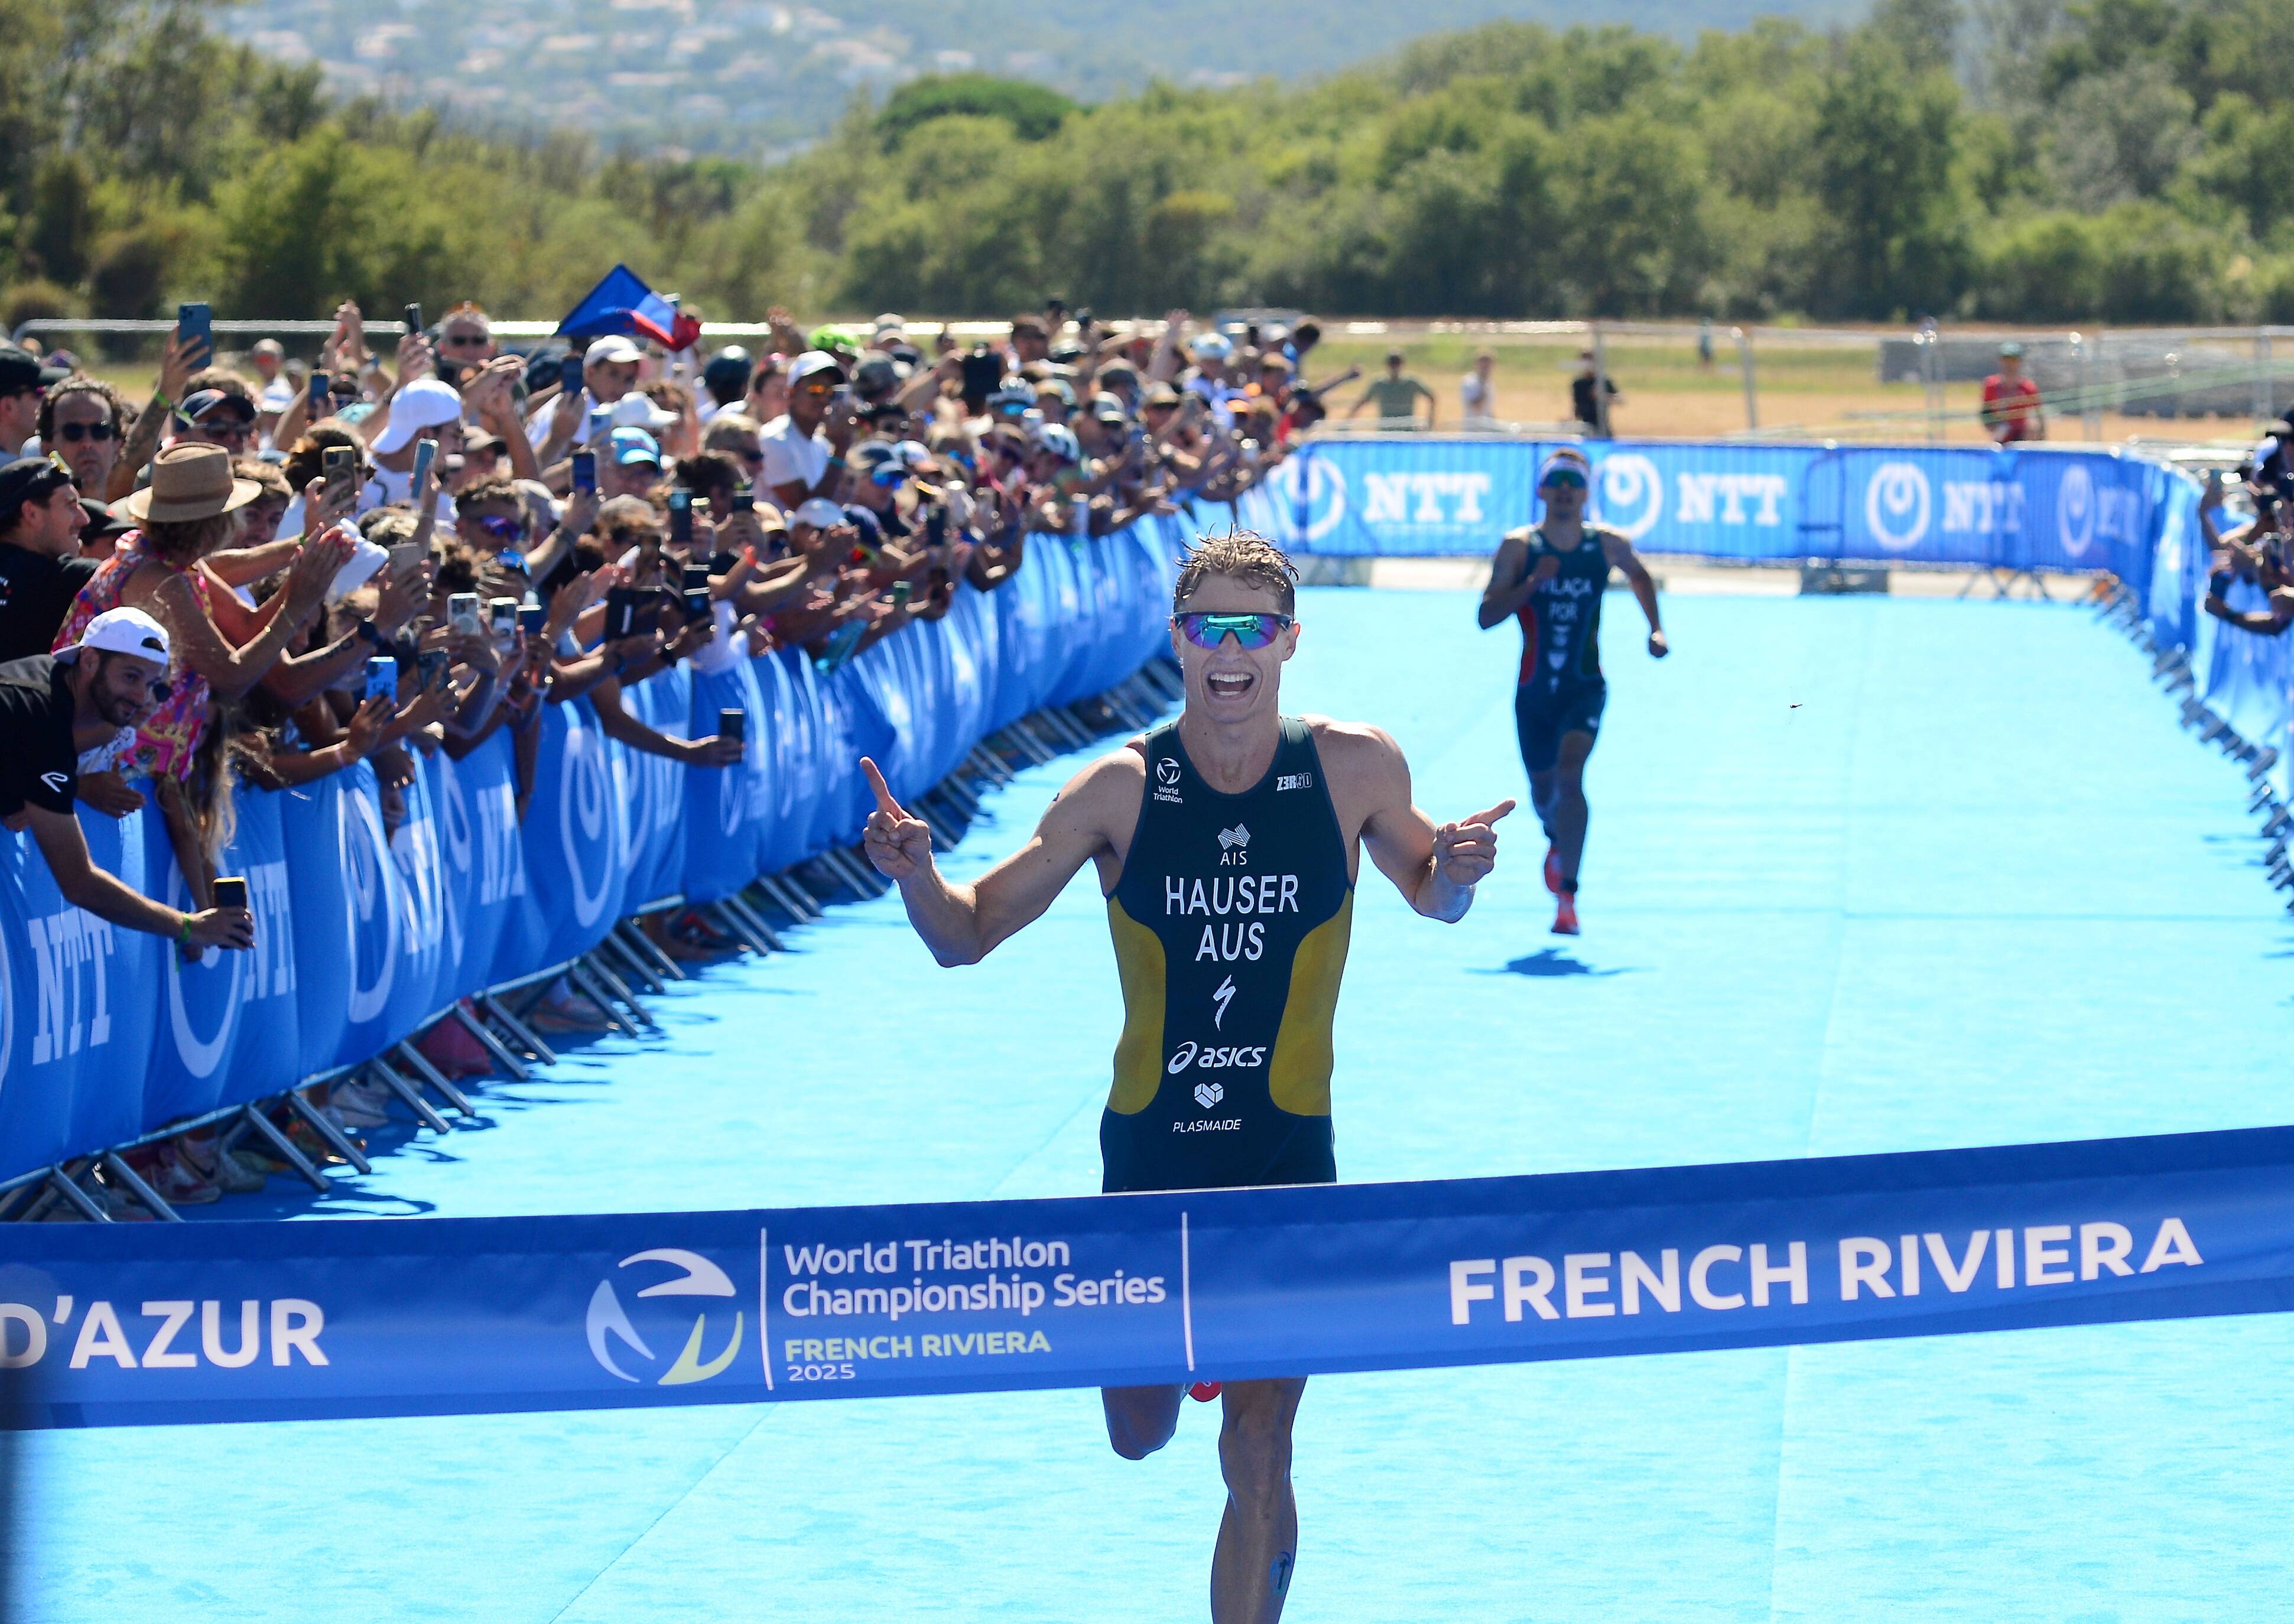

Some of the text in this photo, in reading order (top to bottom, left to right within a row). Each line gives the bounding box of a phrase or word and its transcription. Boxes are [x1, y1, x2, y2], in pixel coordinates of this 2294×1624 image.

[1363, 472, 1492, 522] NTT
[1677, 473, 1786, 526] NTT
[1942, 481, 2025, 533] NTT
[1549, 600, 1578, 621] POR
[1153, 792, 1182, 804] Triathlon
[1158, 785, 1179, 795] World
[1220, 850, 1247, 866] AIS
[1165, 874, 1299, 916] HAUSER
[1195, 921, 1265, 962] AUS
[28, 905, 114, 1065] NTT
[1172, 1119, 1242, 1133] PLASMAIDE
[784, 1236, 1071, 1275] World Triathlon
[1449, 1217, 2204, 1326] FRENCH RIVIERA
[782, 1269, 1167, 1321] Championship Series
[0, 1295, 330, 1369] D'AZUR
[784, 1330, 1052, 1363] FRENCH RIVIERA
[787, 1362, 856, 1382] 2025
